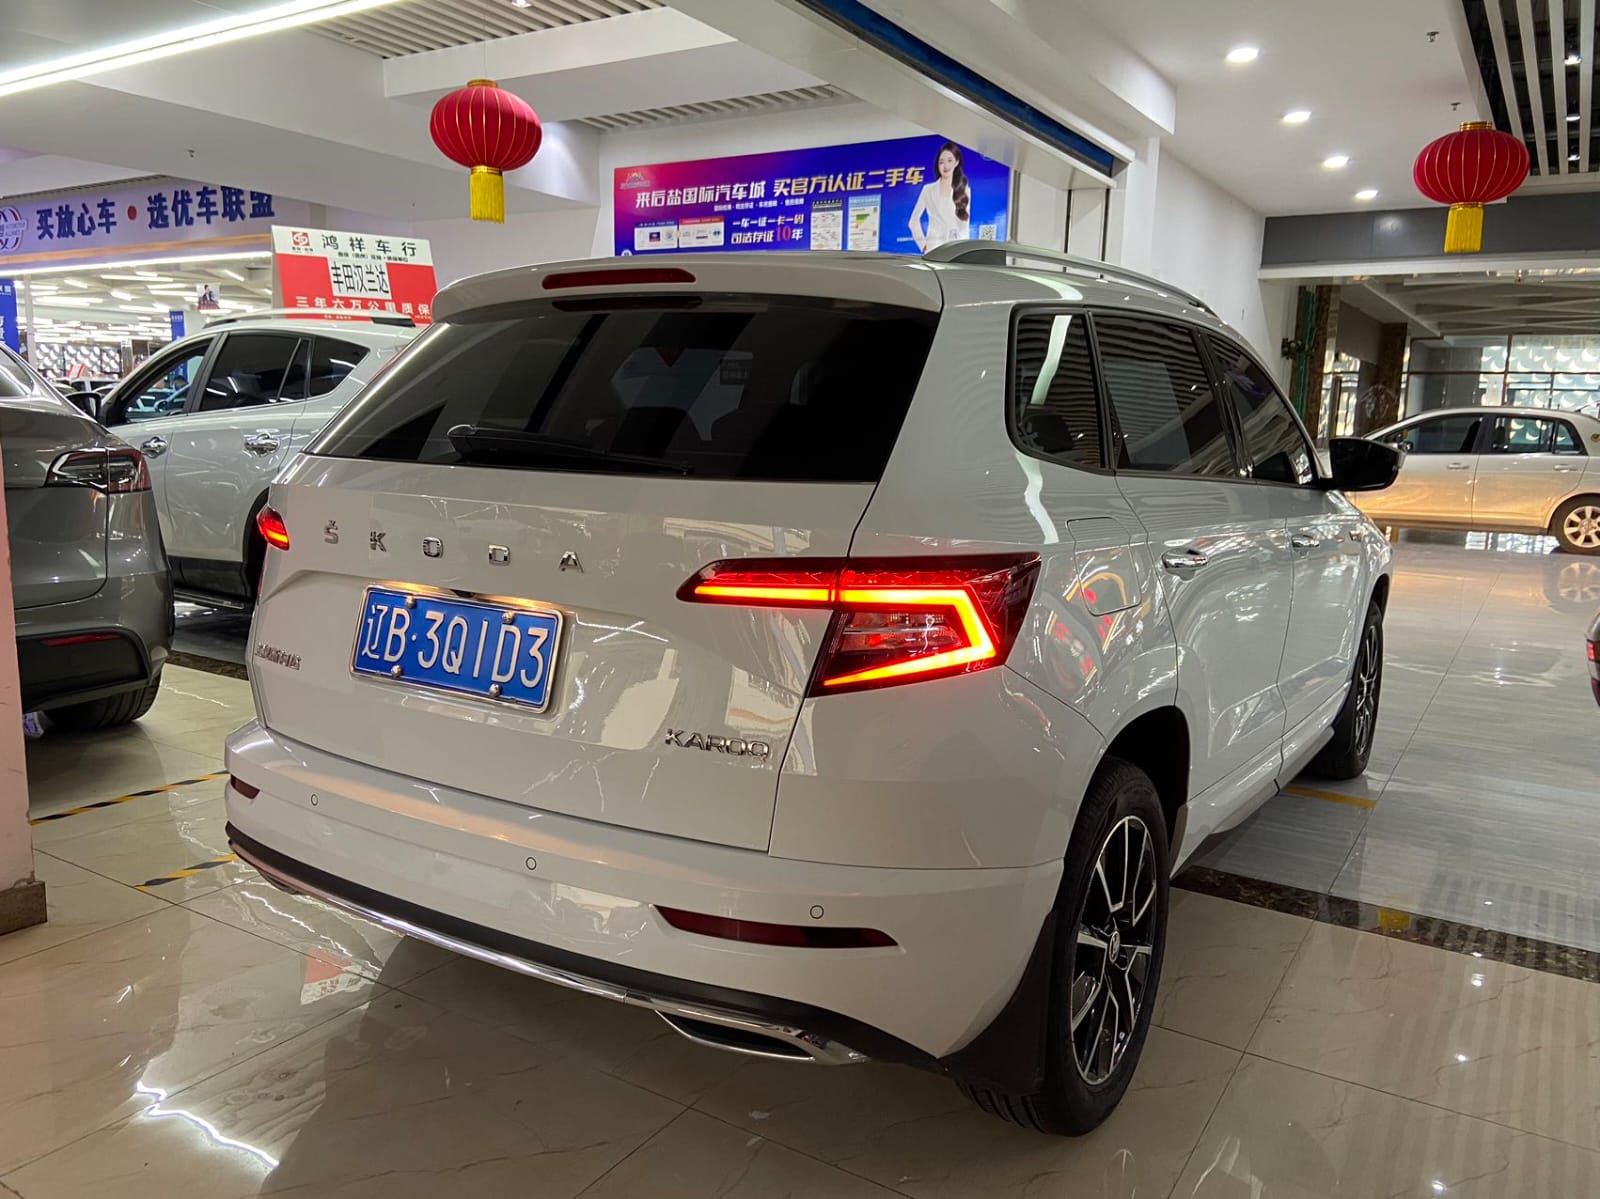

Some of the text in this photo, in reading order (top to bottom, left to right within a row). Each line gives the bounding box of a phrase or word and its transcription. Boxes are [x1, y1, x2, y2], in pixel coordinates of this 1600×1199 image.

[635, 180, 766, 209] 来后盐国际汽车城
[773, 166, 926, 197] 买官方认证二手车
[36, 185, 275, 240] 买放心车 选优车联盟
[321, 234, 417, 257] 鸿祥车行
[331, 260, 390, 295] 丰田汉兰达
[295, 295, 431, 316] 三年六万公里质保
[665, 728, 770, 762] KAROQ
